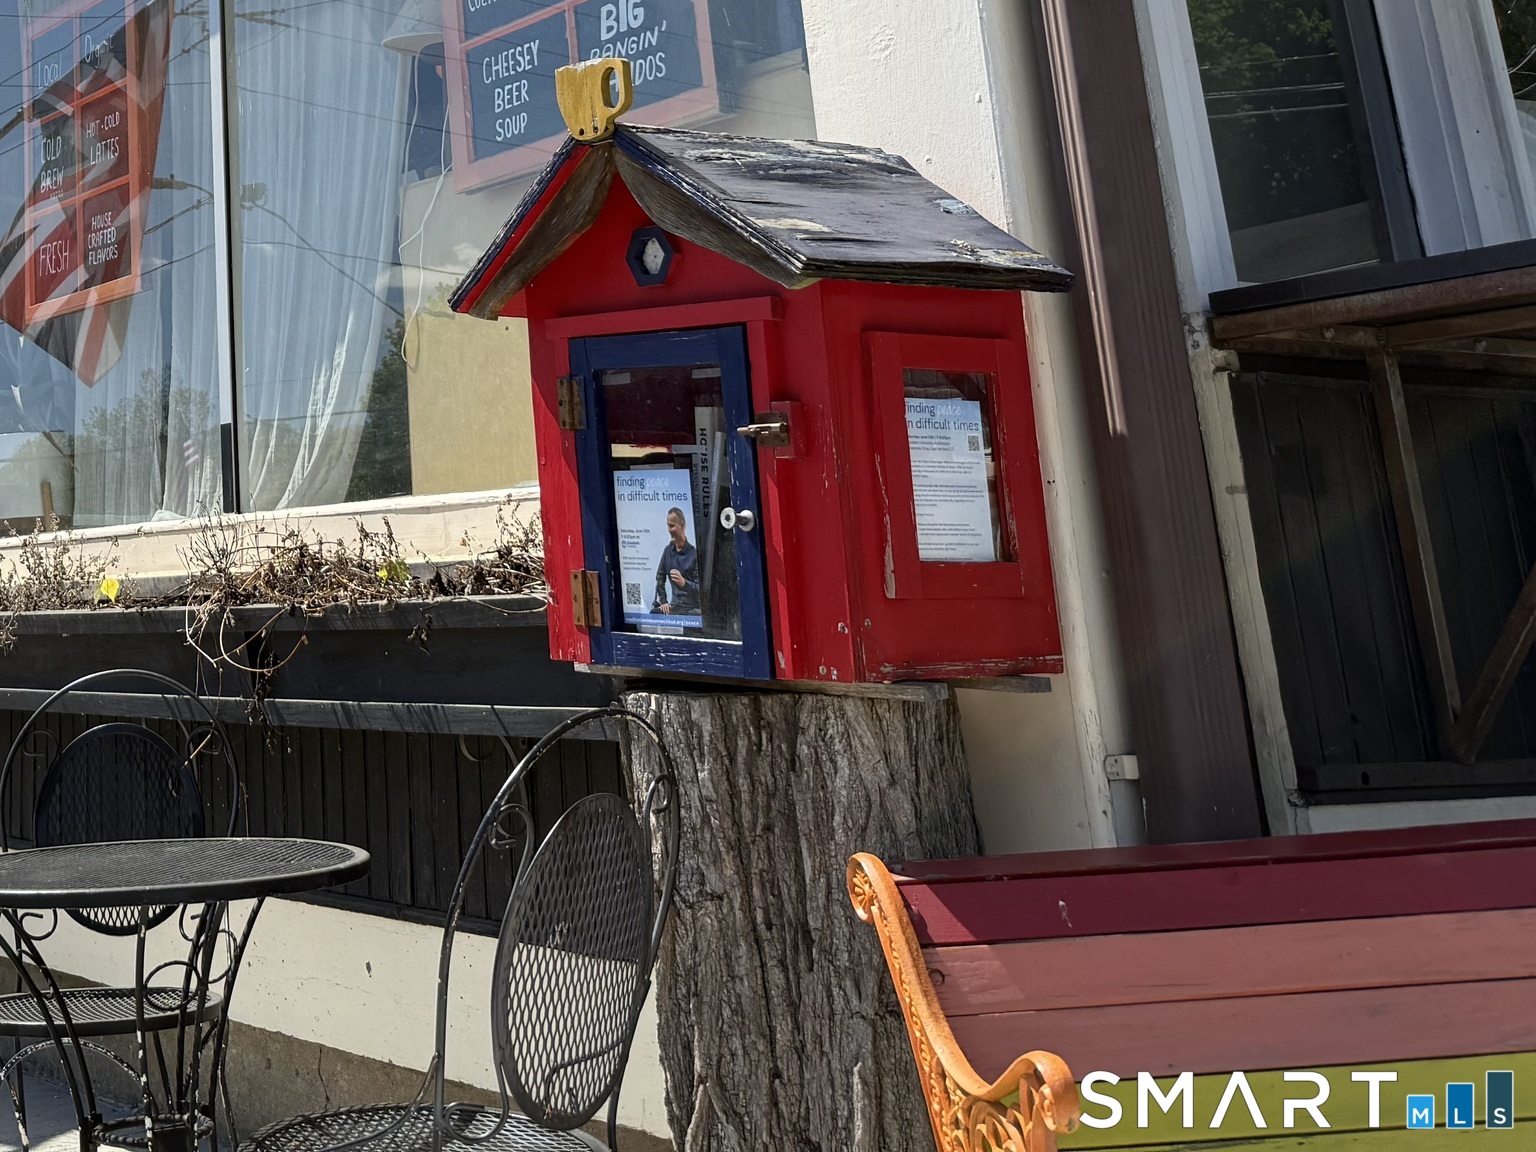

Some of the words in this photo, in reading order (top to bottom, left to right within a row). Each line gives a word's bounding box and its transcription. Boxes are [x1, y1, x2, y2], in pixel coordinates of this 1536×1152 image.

[84, 33, 114, 68] Organic
[483, 39, 539, 83] CHEESEY
[38, 54, 62, 89] Local
[494, 79, 529, 113] BEER
[85, 119, 100, 139] HOT
[104, 111, 120, 131] COLD
[495, 112, 527, 141] SOUP
[41, 136, 62, 163] COLD
[90, 136, 120, 165] LATTES
[40, 166, 64, 193] BREW
[91, 212, 112, 230] HOUSE
[88, 227, 116, 249] CRAFTED
[39, 239, 70, 277] FRESH
[88, 245, 118, 266] FLAVORS
[916, 418, 952, 430] difficult
[954, 419, 979, 431] times
[617, 476, 645, 489] finding
[617, 491, 625, 501] in
[627, 490, 660, 501] difficult
[662, 490, 688, 501] times
